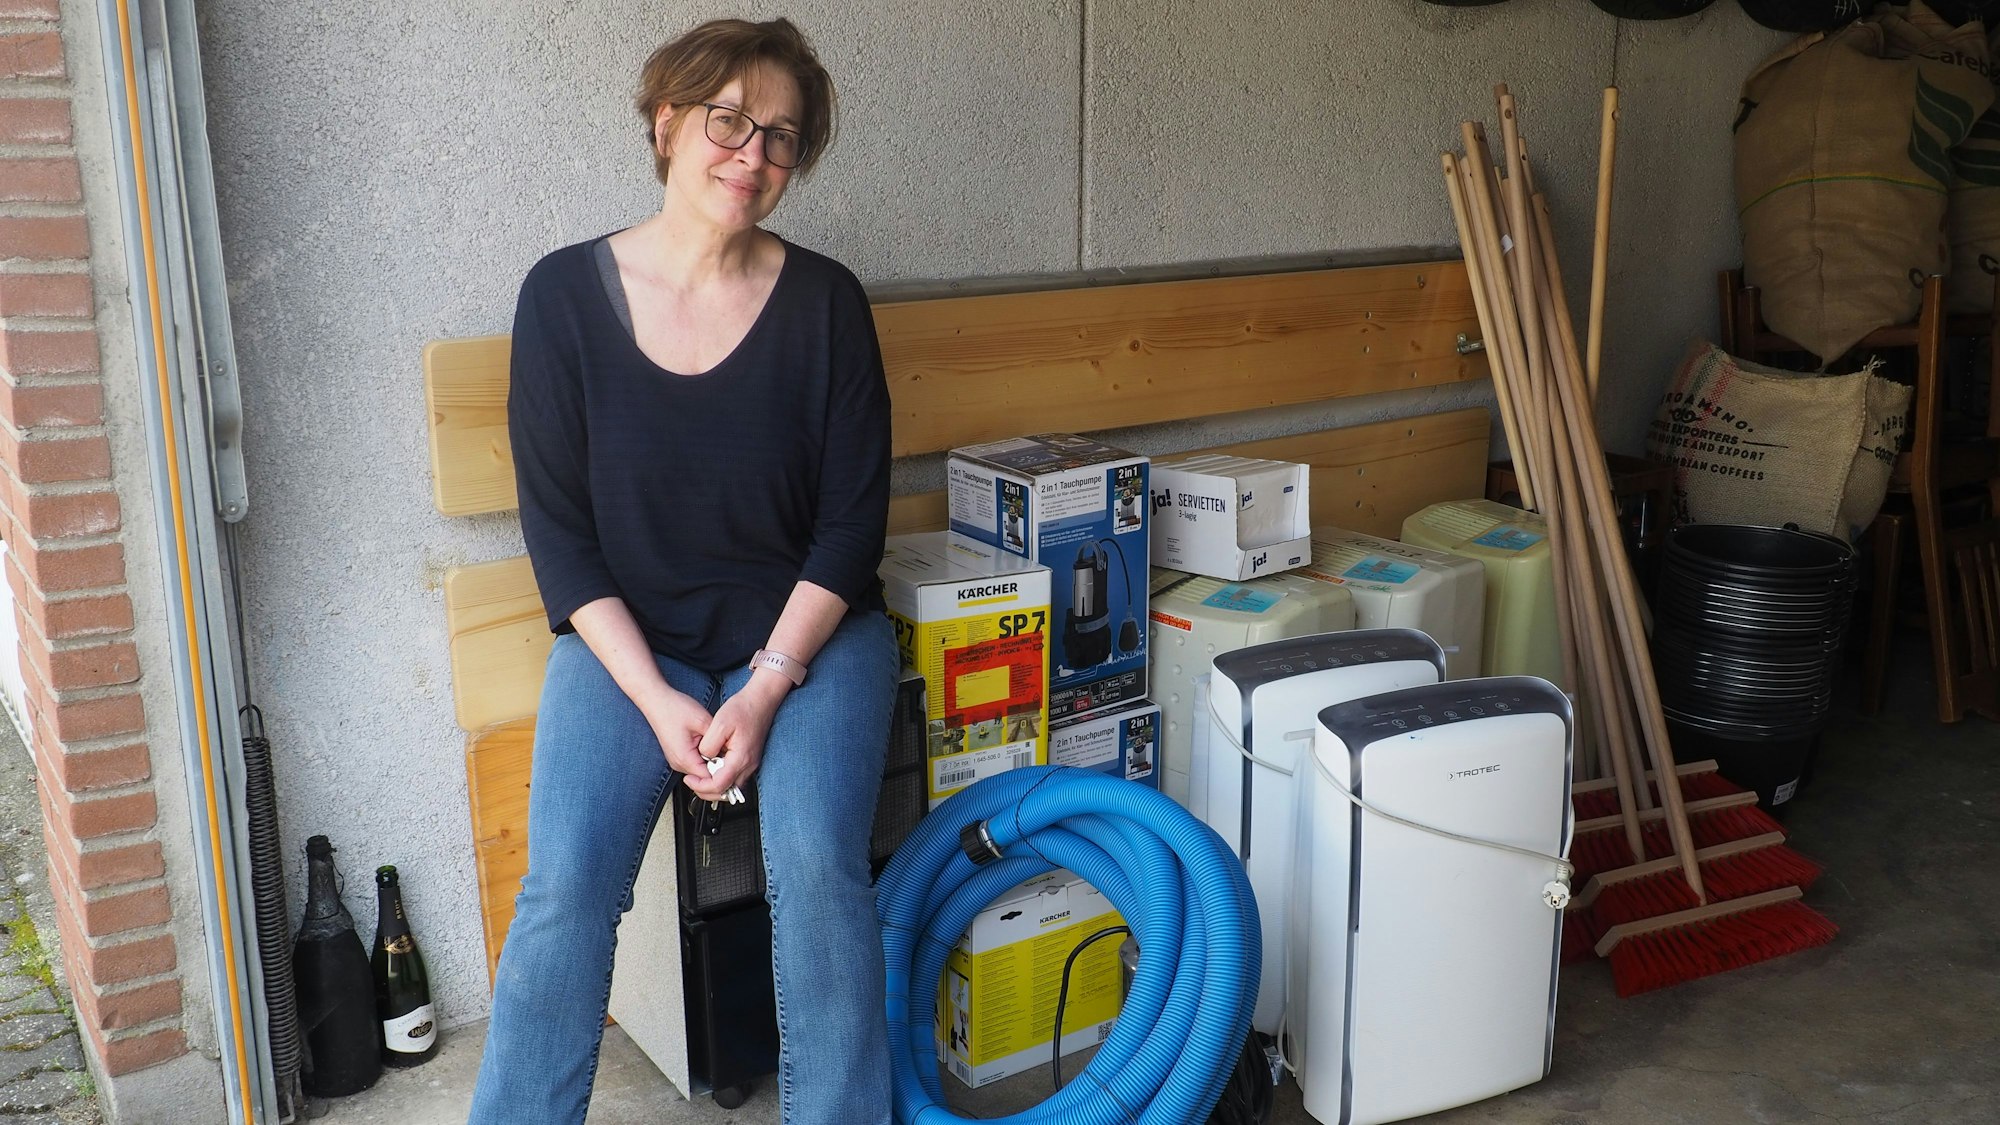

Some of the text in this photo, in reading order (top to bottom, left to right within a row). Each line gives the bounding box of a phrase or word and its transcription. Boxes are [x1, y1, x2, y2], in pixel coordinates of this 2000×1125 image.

[1672, 424, 1738, 444] EXPORTERS
[1692, 441, 1715, 452] AND
[1718, 446, 1765, 461] EXPORT
[962, 470, 992, 486] Tauchpumpe
[1711, 464, 1764, 480] COFFEES
[1060, 475, 1102, 489] Tauchpumpe
[1150, 489, 1225, 516] ja! SERVIETTEN
[1242, 491, 1252, 507] ja!
[1179, 510, 1197, 522] 3-lagig
[1252, 552, 1267, 574] ja!
[958, 582, 1018, 600] KÄRCHER
[999, 614, 1028, 639] SP
[1075, 727, 1114, 742] Tauchpumpe
[1456, 764, 1500, 778] TROTEC
[1040, 910, 1070, 924] KÄRCHER
